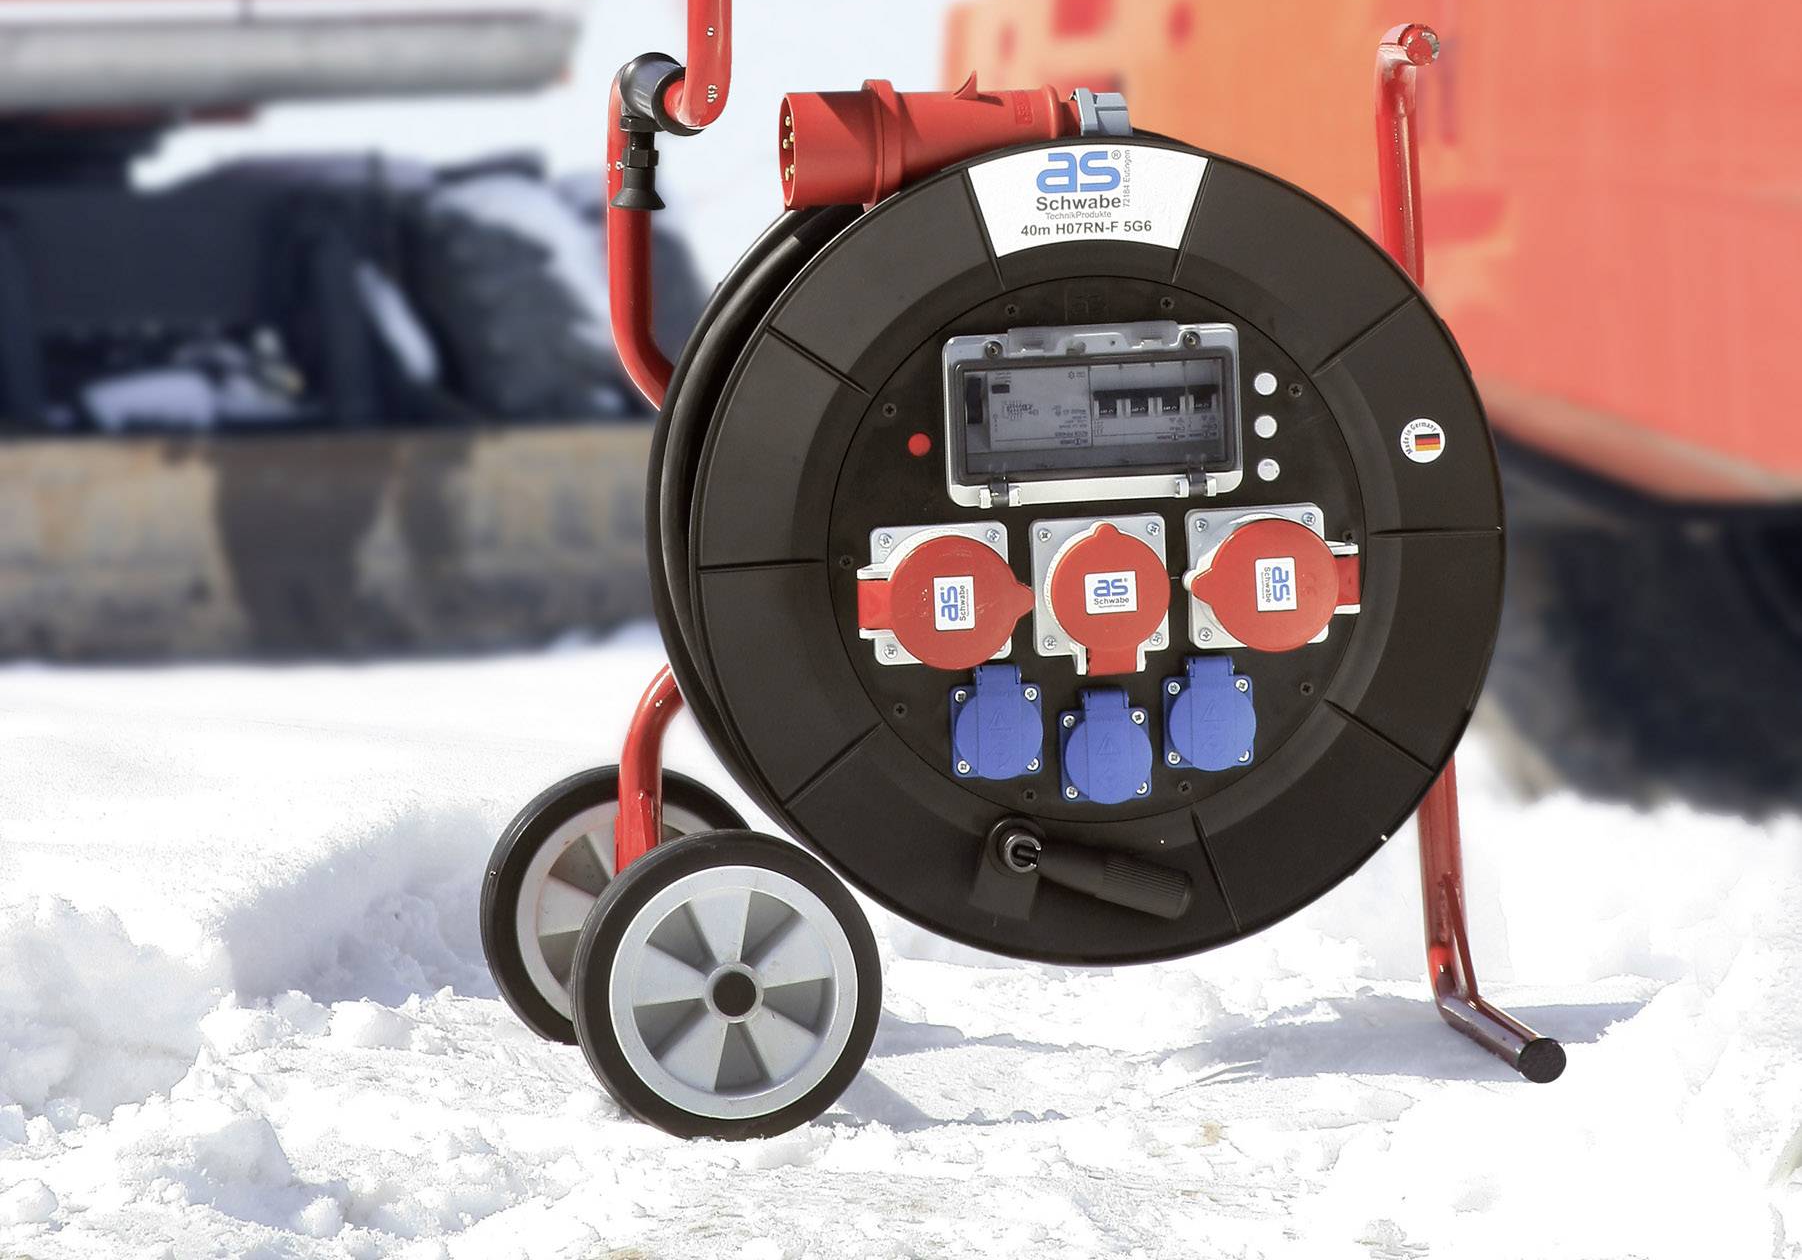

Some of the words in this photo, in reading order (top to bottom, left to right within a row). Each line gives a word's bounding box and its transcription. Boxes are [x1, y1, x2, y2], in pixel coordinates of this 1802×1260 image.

[1036, 194, 1121, 211] Schwabe
[1045, 210, 1112, 221] TechnikProdukte
[1021, 224, 1051, 236] 40m
[1056, 221, 1119, 235] H07RN-F
[1123, 220, 1152, 232] 5G6
[1263, 566, 1272, 603] Schwabe
[959, 585, 967, 622] Schwabe
[1093, 597, 1129, 606] Schwabe
